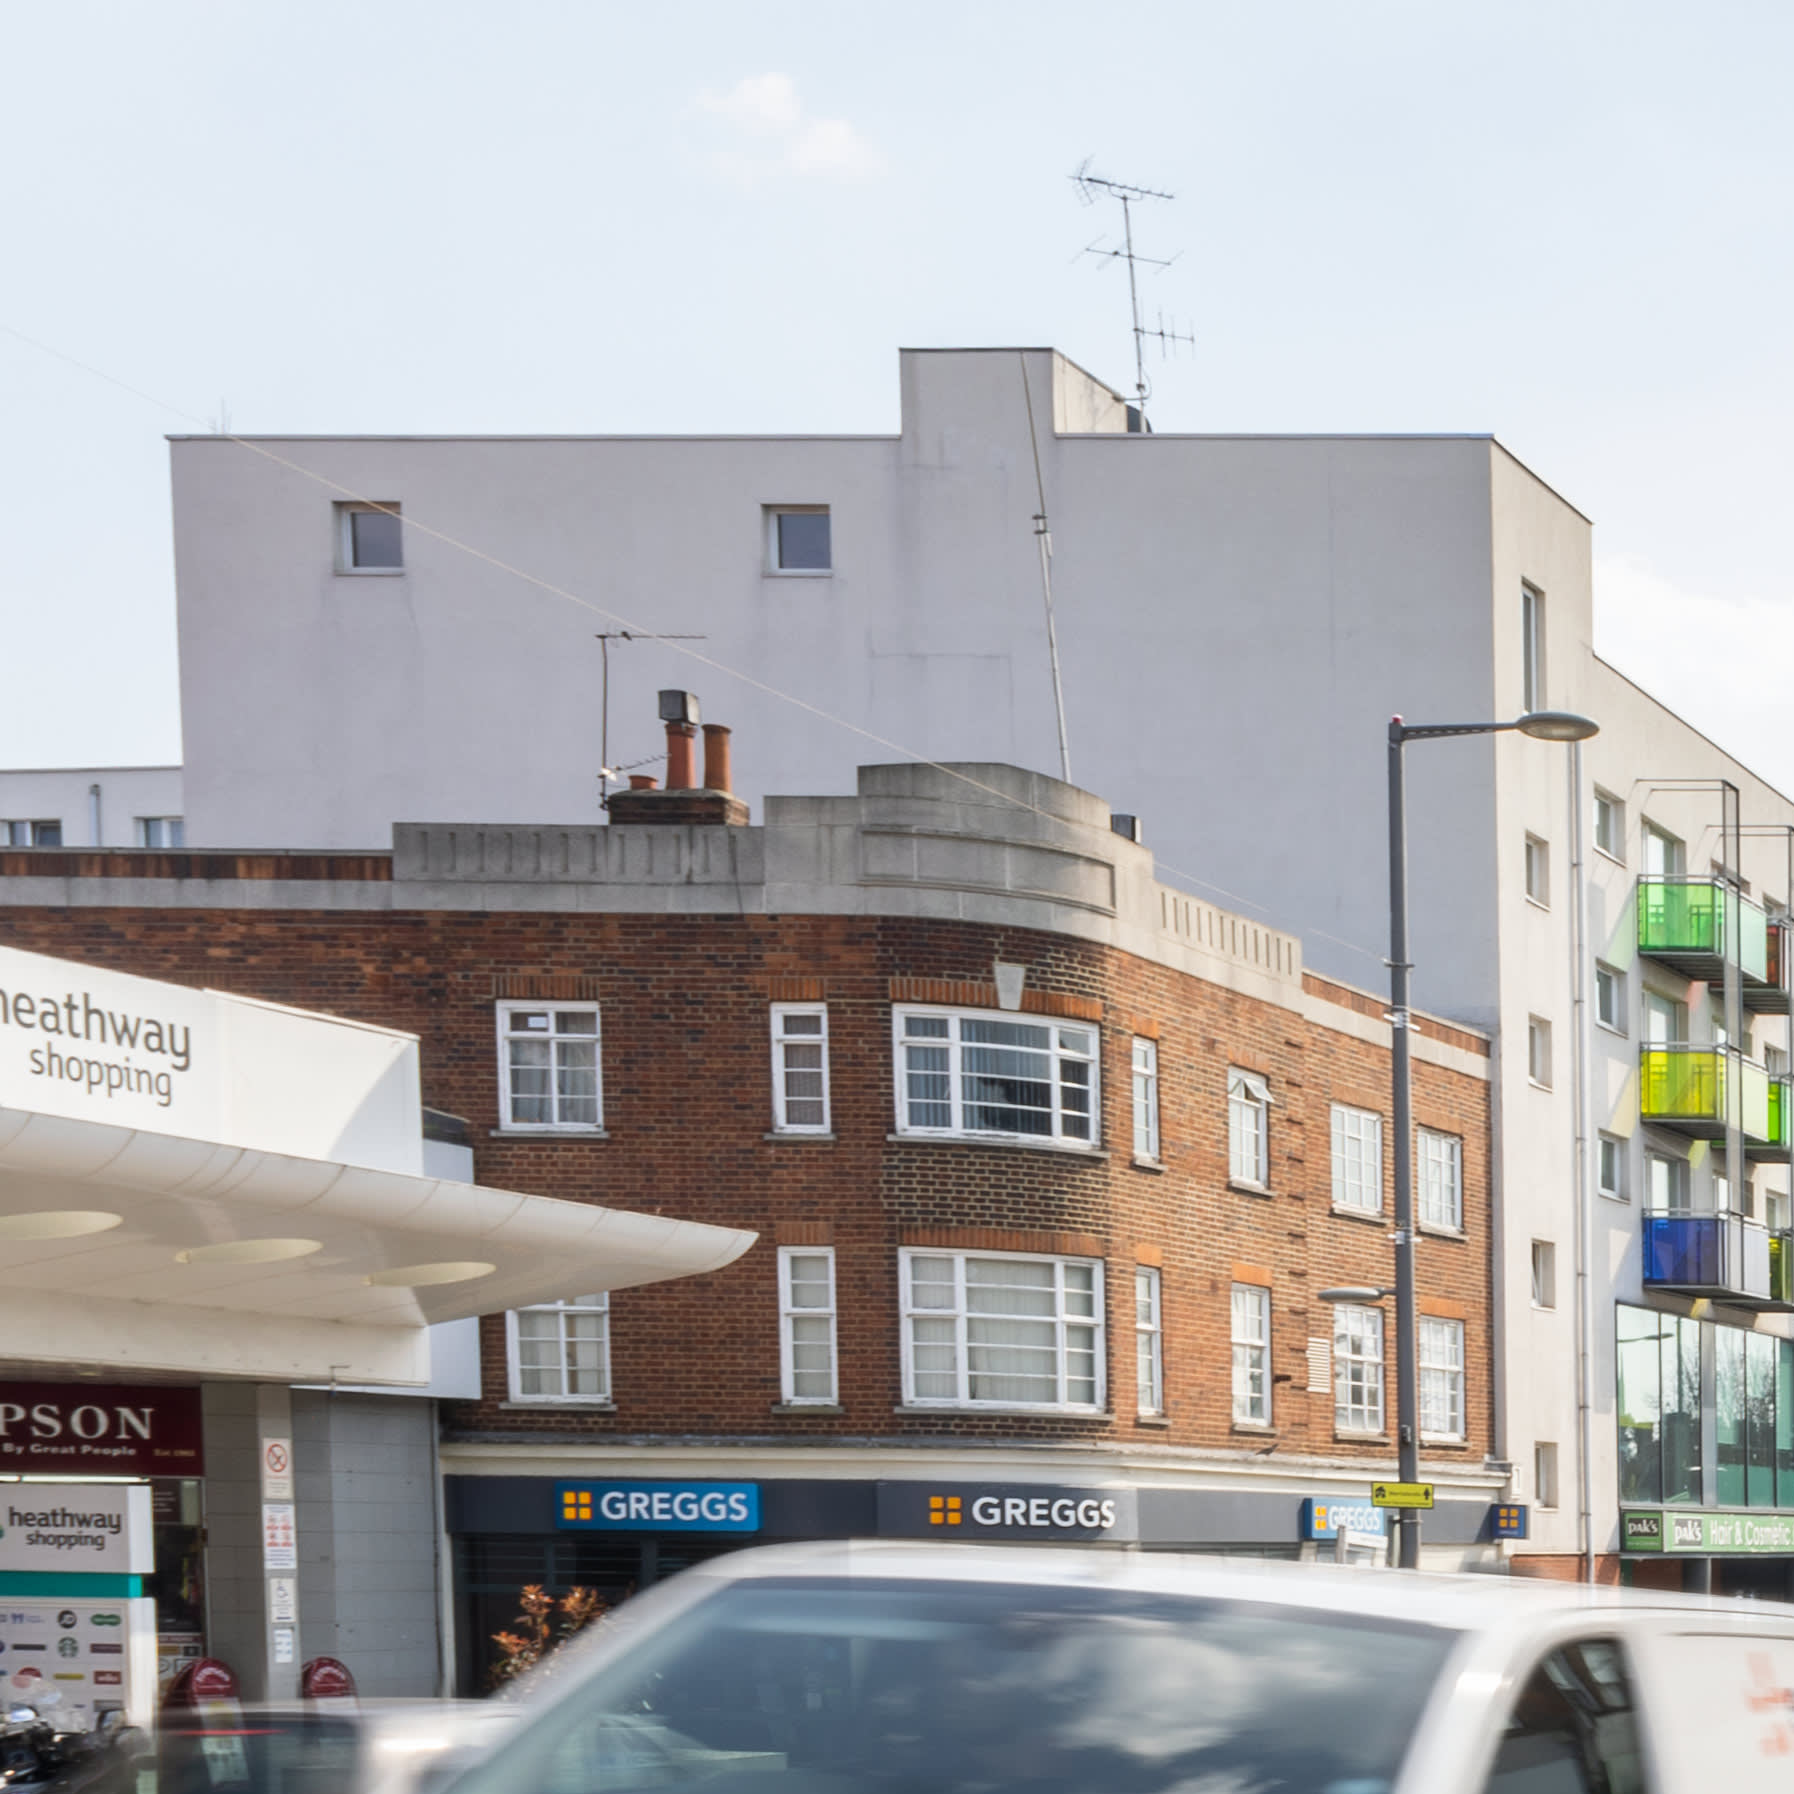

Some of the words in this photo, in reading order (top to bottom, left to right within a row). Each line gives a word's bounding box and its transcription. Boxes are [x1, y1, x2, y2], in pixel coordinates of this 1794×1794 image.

[30, 1041, 172, 1107] shopping
[8, 1506, 122, 1535] heathway
[600, 1490, 749, 1522] GREGGS
[971, 1496, 1116, 1529] GREGGS
[1328, 1505, 1381, 1531] GREGGS
[26, 1530, 105, 1551] shopping
